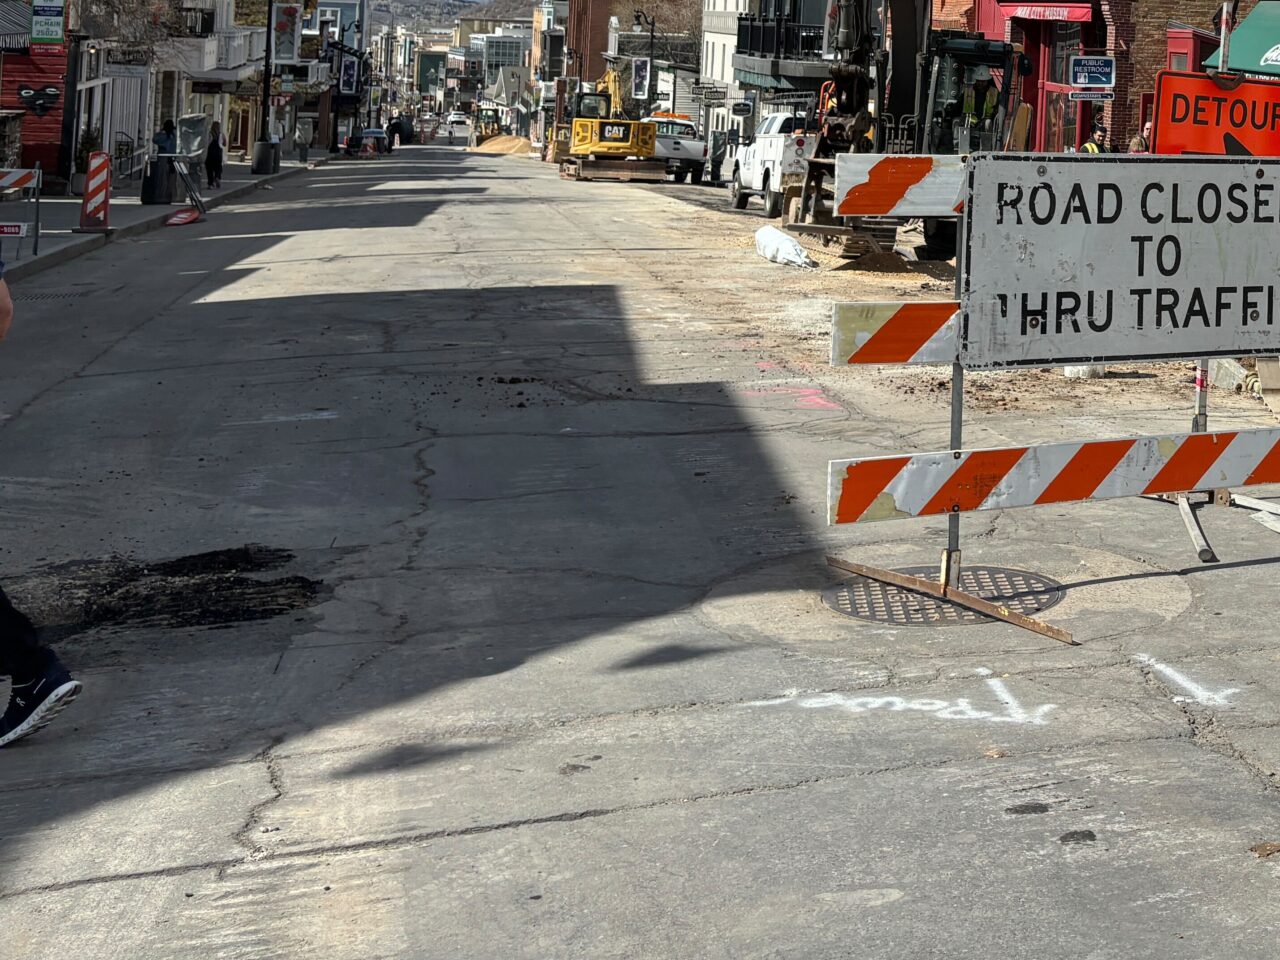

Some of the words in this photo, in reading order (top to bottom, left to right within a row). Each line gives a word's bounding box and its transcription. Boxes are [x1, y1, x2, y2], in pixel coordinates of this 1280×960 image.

[604, 125, 625, 137] CAT
[996, 181, 1123, 225] ROAD
[1130, 235, 1182, 277] TO
